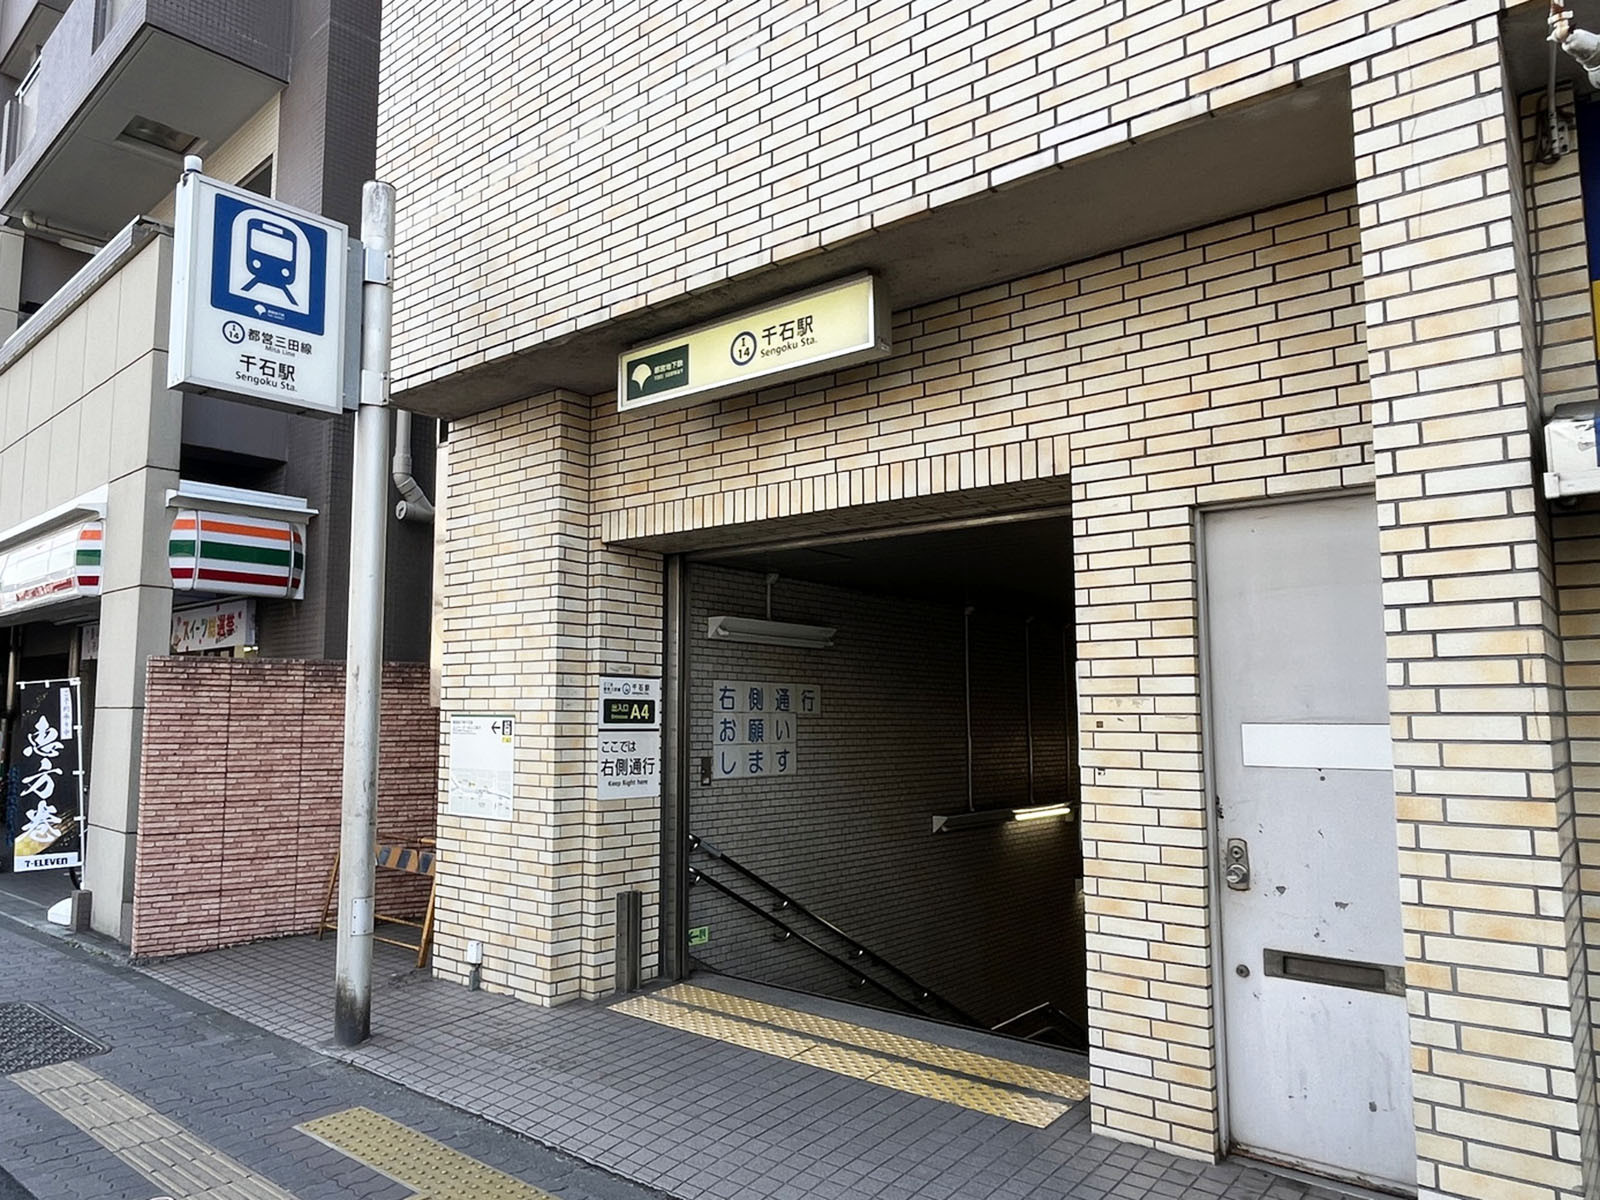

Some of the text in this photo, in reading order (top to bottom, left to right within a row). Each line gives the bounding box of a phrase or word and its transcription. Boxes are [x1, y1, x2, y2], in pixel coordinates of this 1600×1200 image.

[229, 331, 239, 339] 14
[248, 329, 312, 355] 都営三田線
[761, 315, 813, 346] 千石駅
[738, 346, 750, 359] 14
[760, 337, 818, 358] Sengoku Sta.
[239, 354, 295, 382] 千石駅
[235, 371, 298, 392] Sengoku Sta.
[718, 685, 816, 713] 右側通行
[611, 703, 629, 713] 出入口
[630, 703, 650, 720] A4
[719, 717, 791, 744] お願い
[601, 740, 636, 753] ここでは
[600, 757, 656, 777] 右側通行
[721, 748, 791, 776] します
[20, 714, 65, 844] 恵方巻
